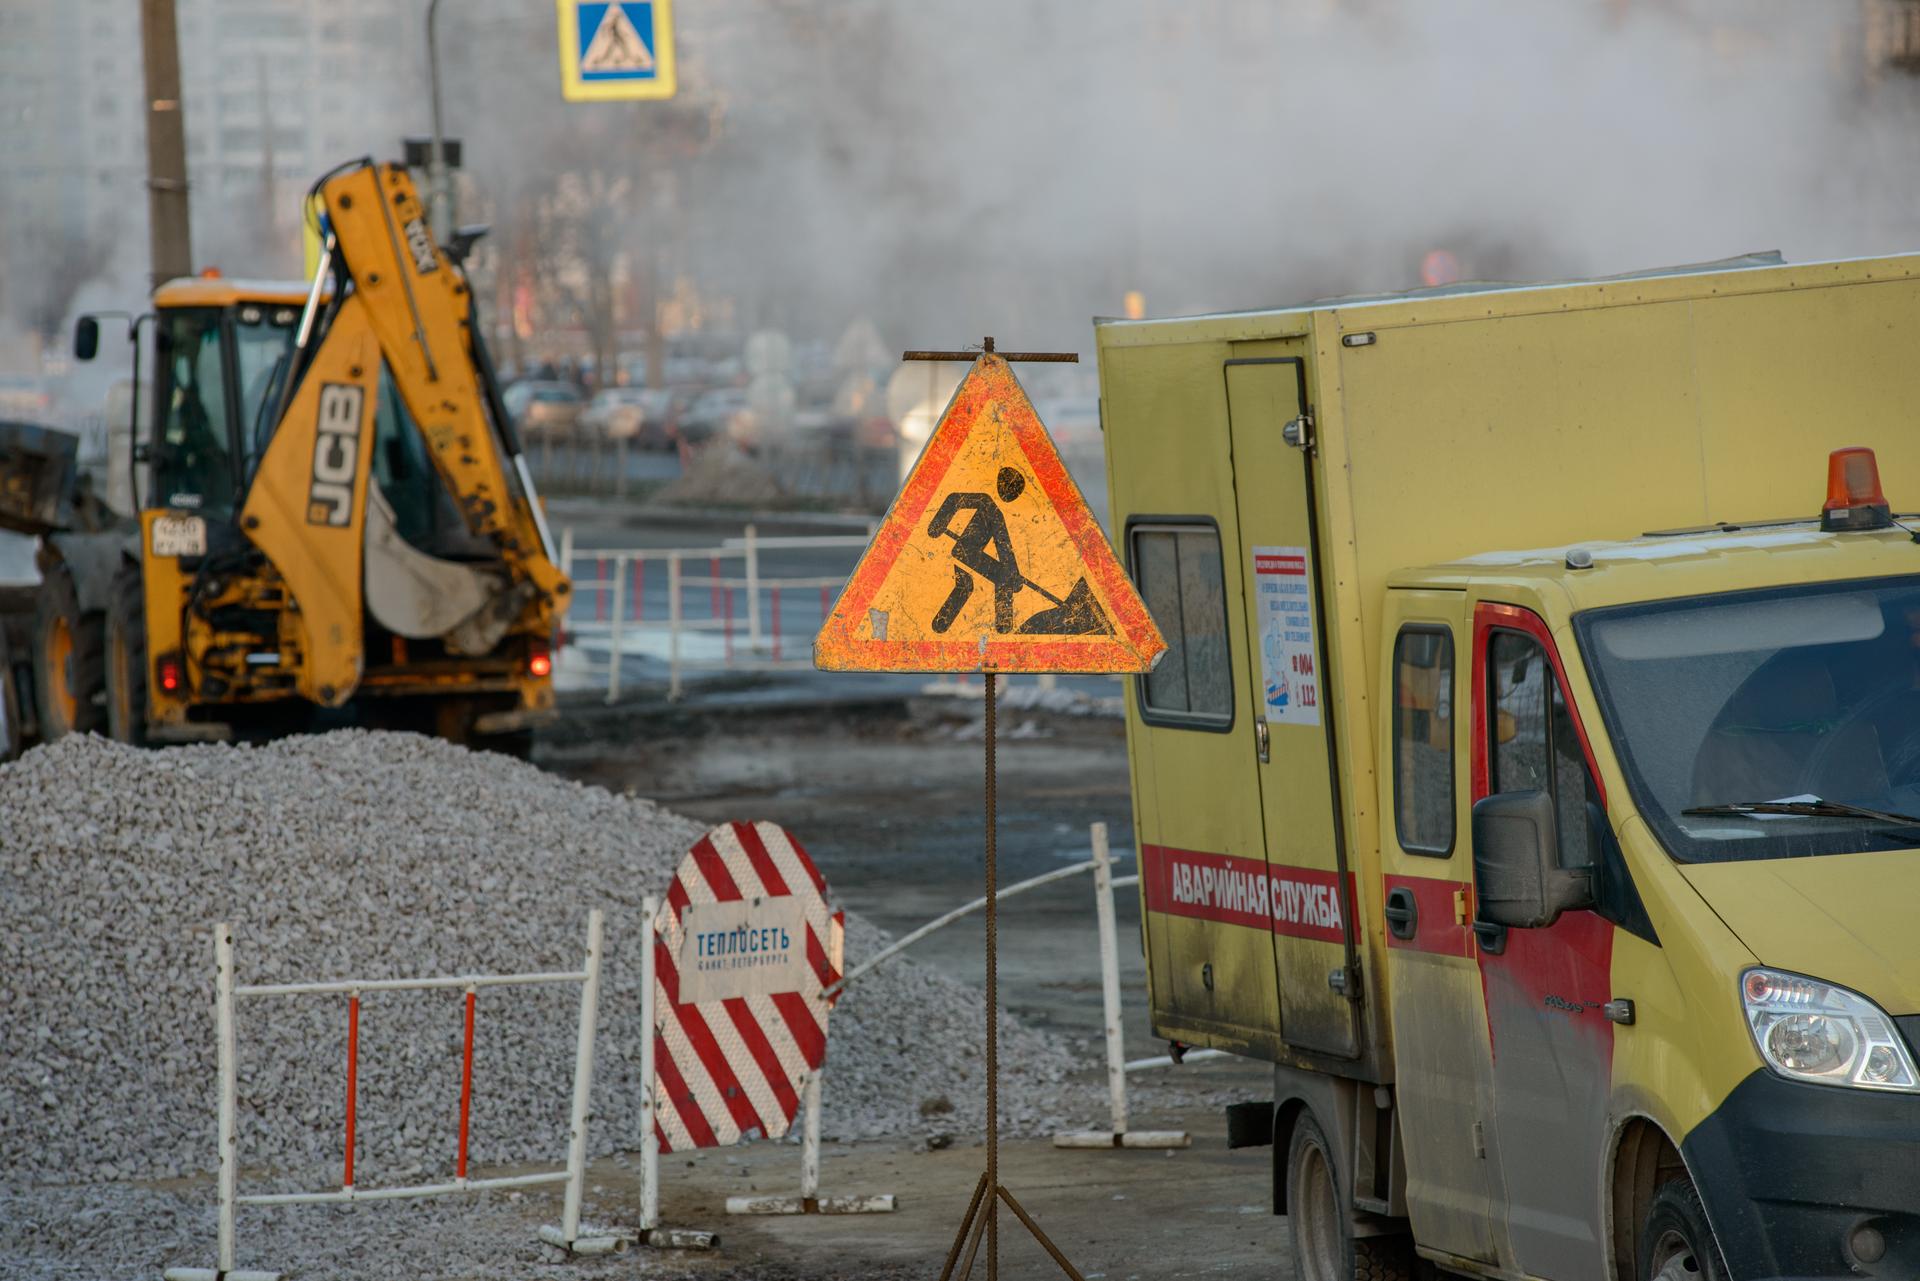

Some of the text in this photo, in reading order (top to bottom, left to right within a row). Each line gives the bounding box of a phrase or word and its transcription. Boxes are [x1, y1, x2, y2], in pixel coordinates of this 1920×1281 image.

[310, 383, 363, 526] JCB
[1299, 653, 1314, 676] 004
[1302, 684, 1316, 707] 112
[1172, 859, 1344, 930] АВАРИЙНАЯ СЛУЖБА
[697, 927, 790, 957] ТЕПЛОСЕТЬ
